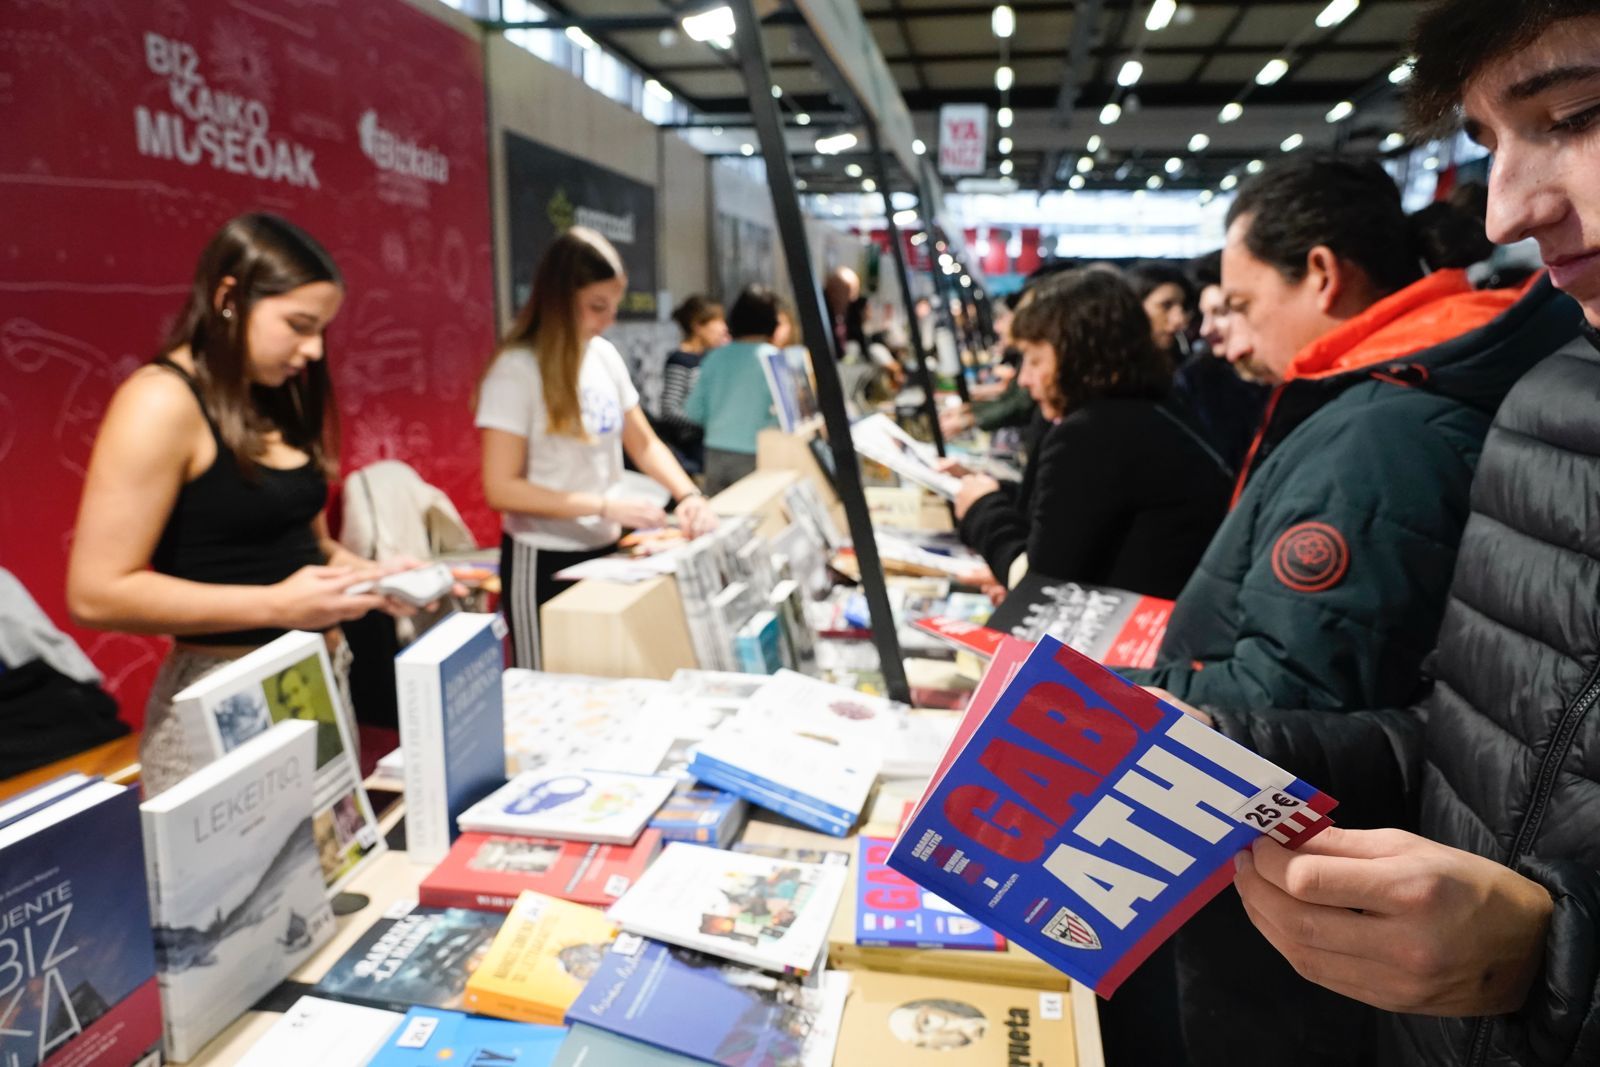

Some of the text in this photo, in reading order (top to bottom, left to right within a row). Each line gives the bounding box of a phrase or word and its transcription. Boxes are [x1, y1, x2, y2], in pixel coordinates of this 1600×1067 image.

[169, 75, 269, 137] KAIKO
[134, 105, 320, 190] MUSEOAK
[1244, 791, 1300, 829] 25 €
[911, 829, 936, 858] GABARRA
[918, 834, 943, 863] ATHLETIC
[942, 849, 965, 874] MEMORIA
[953, 858, 971, 876] VISUAL
